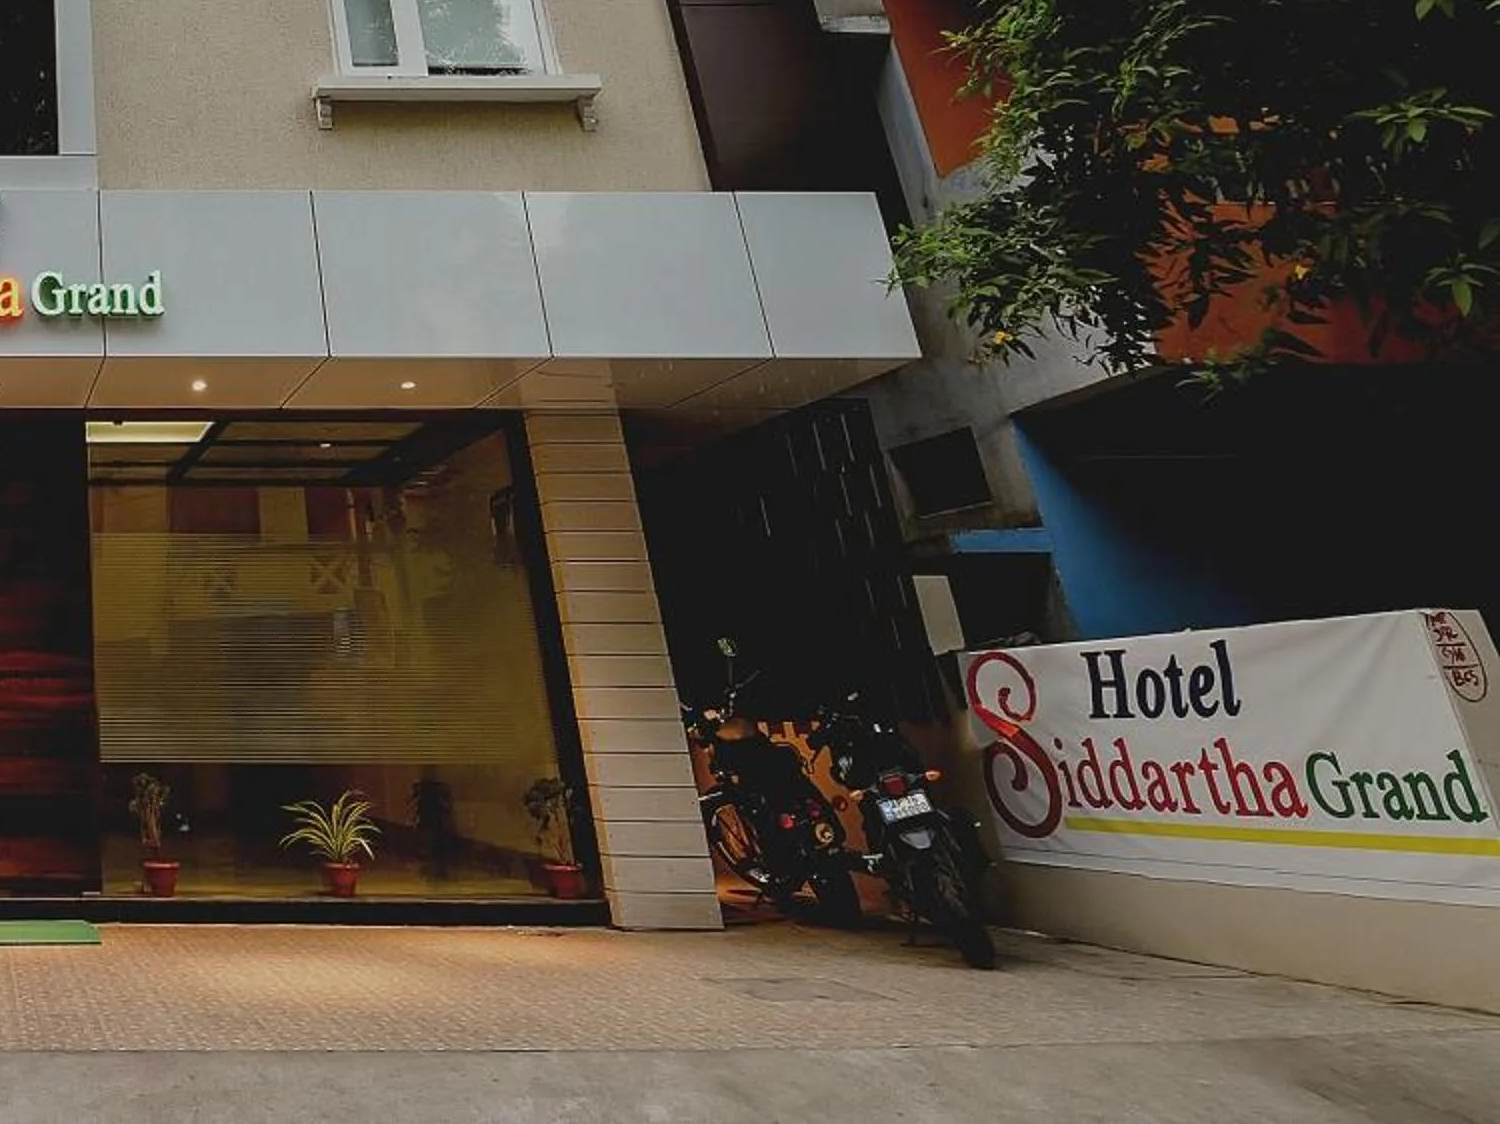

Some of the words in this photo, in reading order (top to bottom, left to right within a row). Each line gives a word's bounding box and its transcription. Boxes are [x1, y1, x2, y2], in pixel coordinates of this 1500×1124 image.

[30, 269, 165, 318] Grand
[1080, 639, 1241, 719] Hotel
[966, 652, 1308, 839] Siddartha
[1305, 749, 1489, 823] Grand
